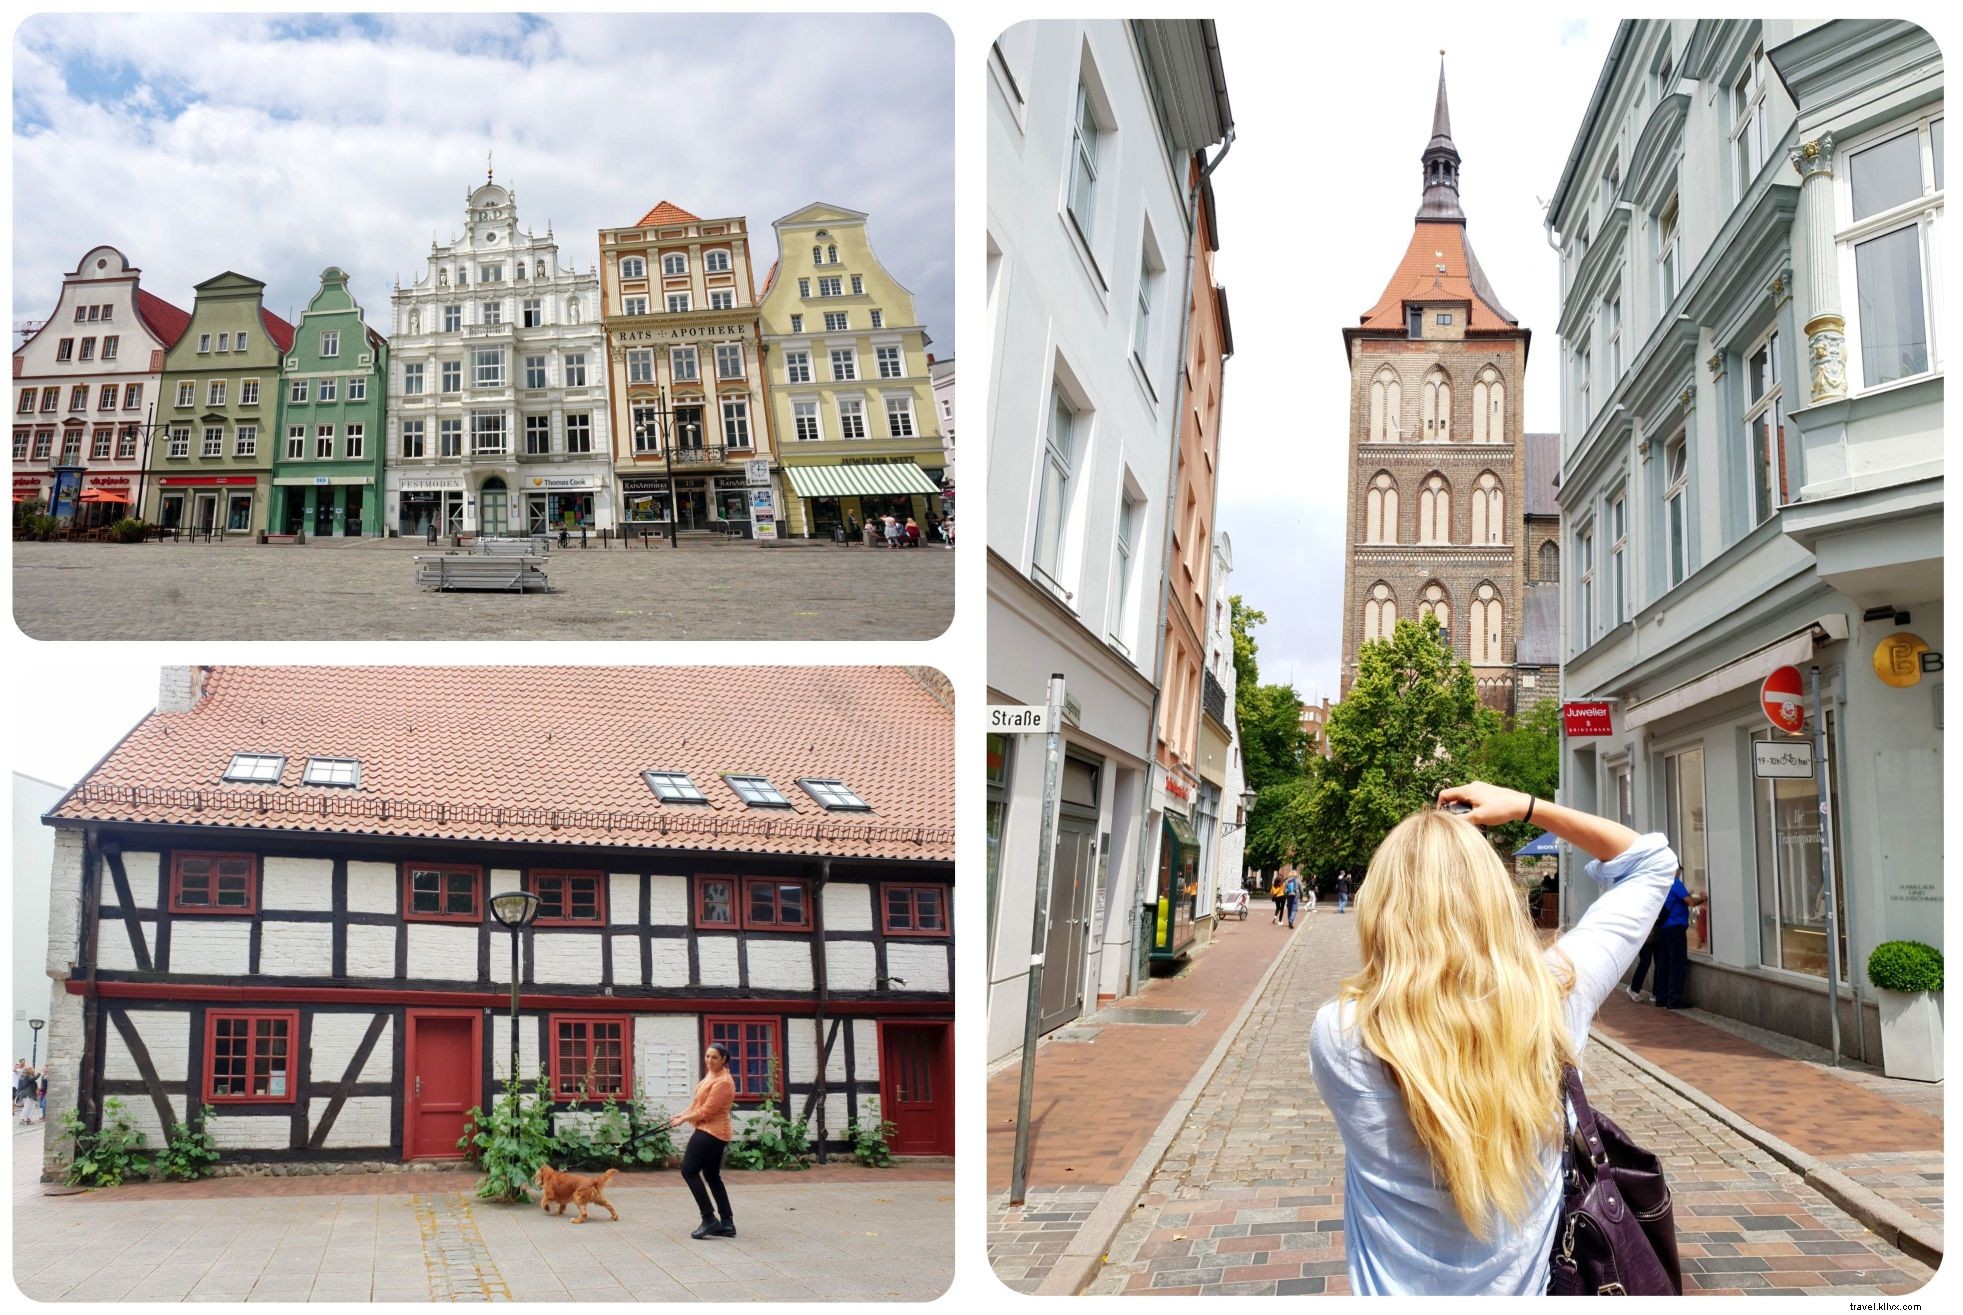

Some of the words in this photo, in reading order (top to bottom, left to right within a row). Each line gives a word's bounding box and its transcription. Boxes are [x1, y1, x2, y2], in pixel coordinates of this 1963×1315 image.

[620, 331, 652, 341] RATS
[671, 325, 746, 338] APOTHEKE
[401, 480, 460, 488] FESTMODEN
[569, 478, 586, 486] Cook
[1921, 652, 1944, 672] B
[992, 710, 1041, 726] Straße
[1567, 708, 1607, 717] Juwelier
